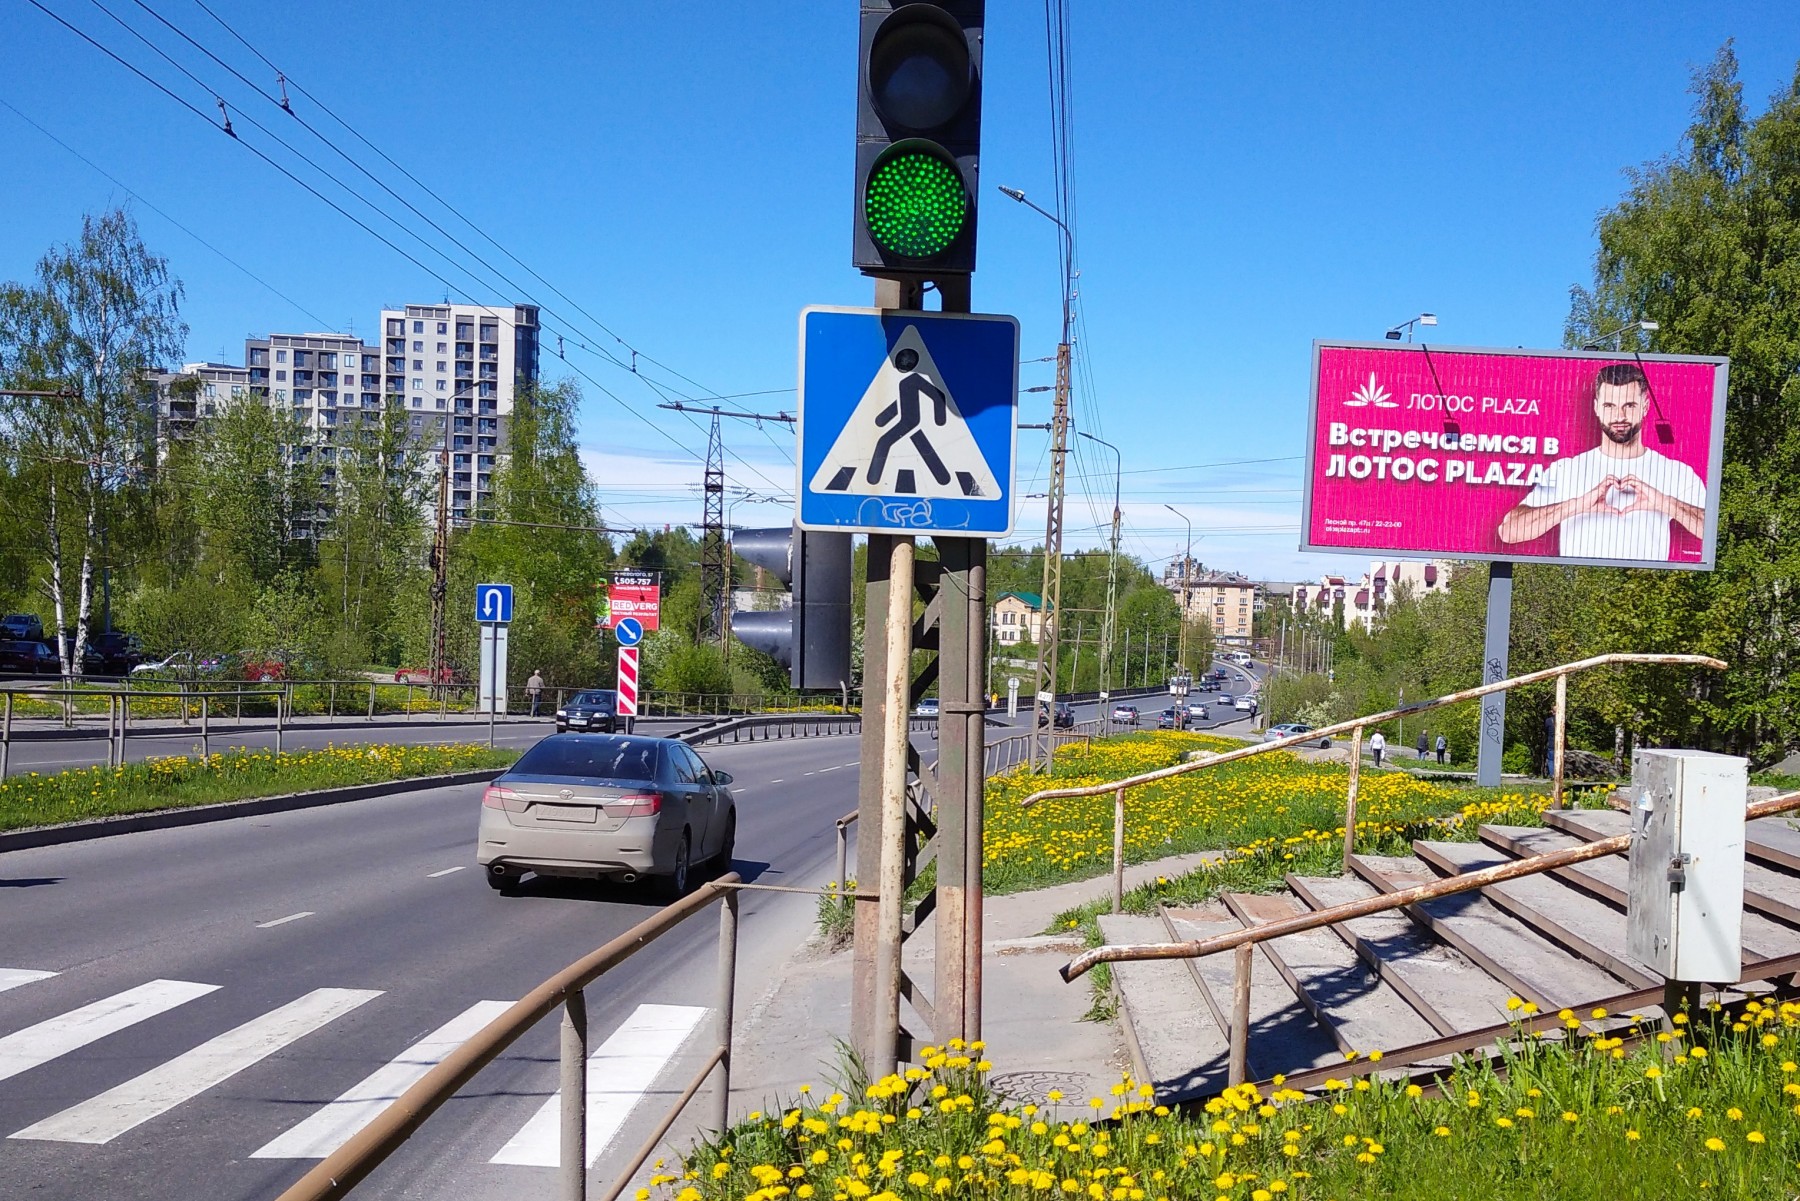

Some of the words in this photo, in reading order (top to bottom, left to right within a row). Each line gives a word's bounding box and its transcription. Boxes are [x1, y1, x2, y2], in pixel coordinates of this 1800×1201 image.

[1406, 393, 1475, 412] ЛОТОС
[1482, 397, 1540, 415] PLAZA
[1329, 422, 1537, 454] Встречаемся
[1543, 437, 1559, 455] в
[1325, 454, 1439, 482] ЛОТОС
[1324, 518, 1347, 526] Лесной
[619, 577, 651, 585] 505-757
